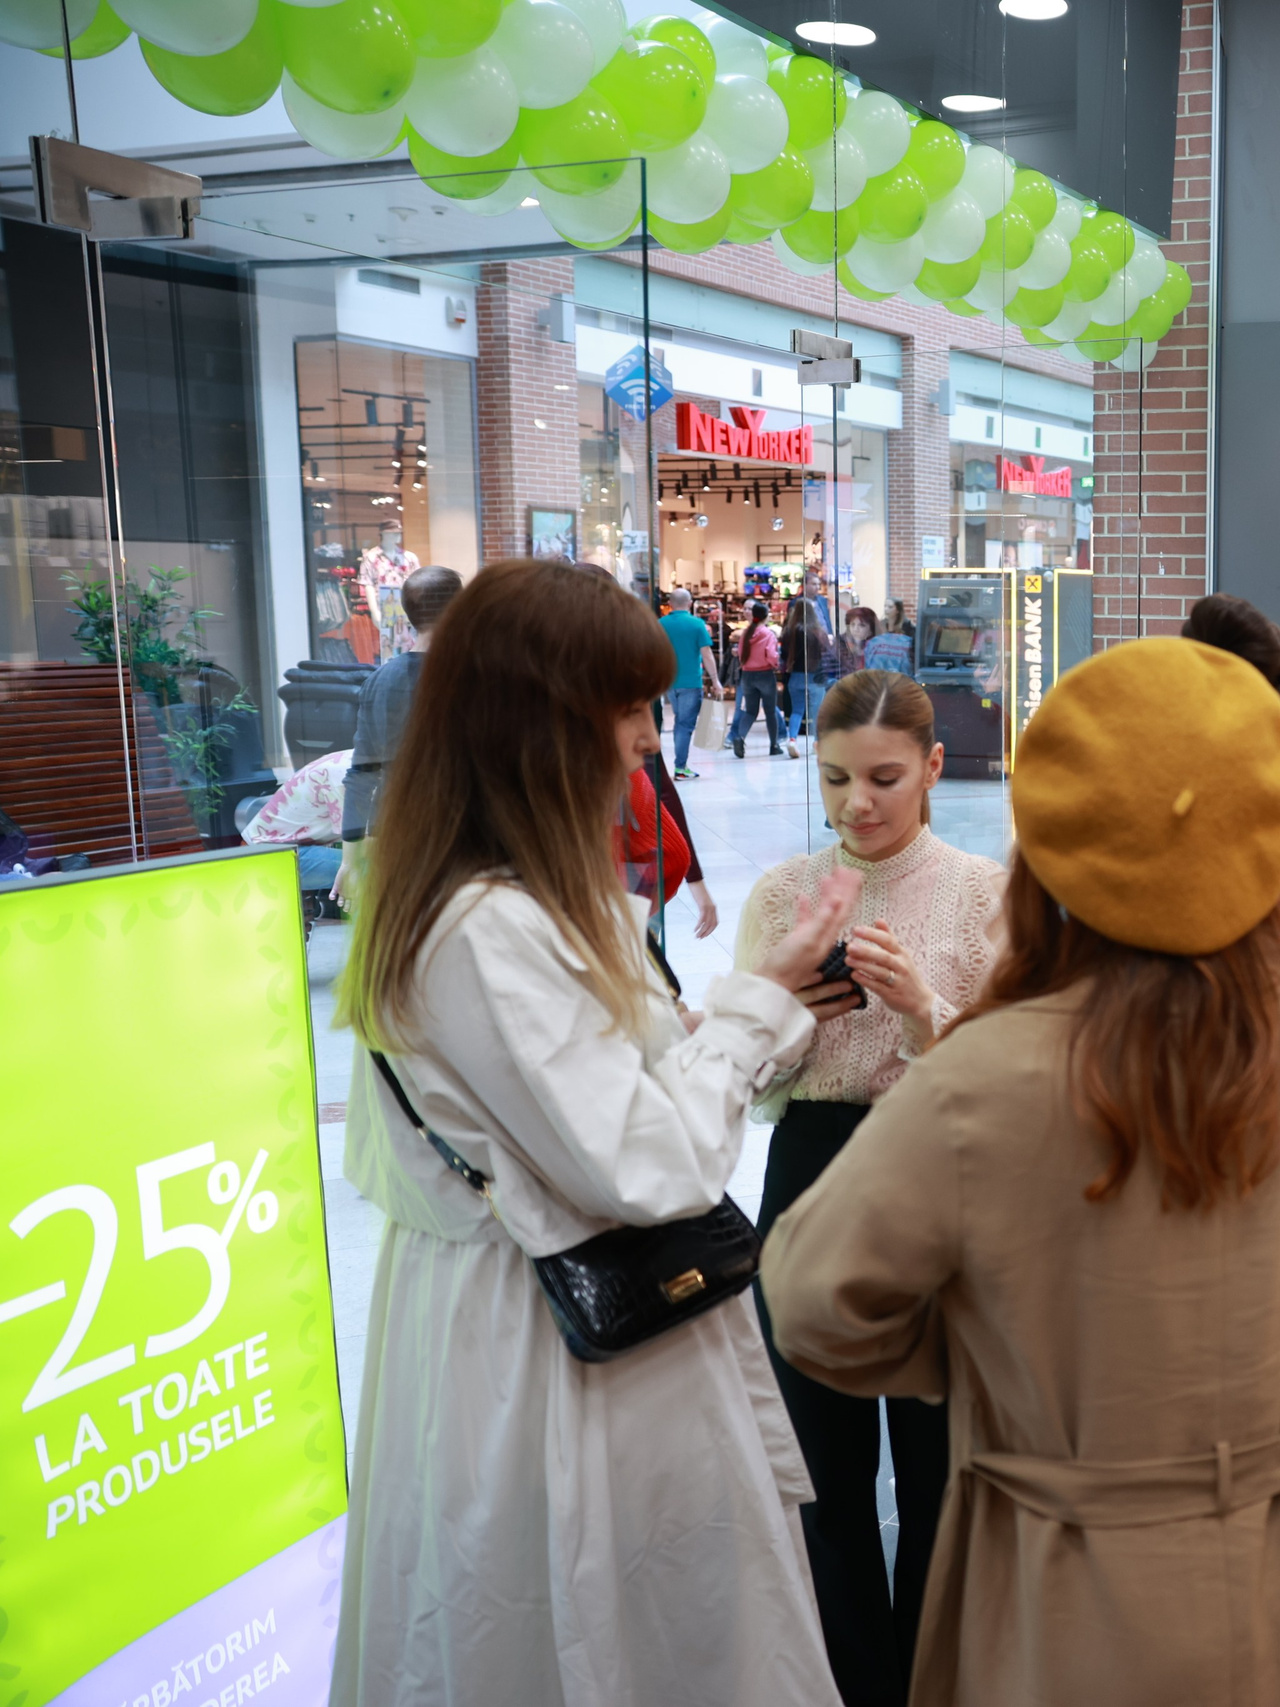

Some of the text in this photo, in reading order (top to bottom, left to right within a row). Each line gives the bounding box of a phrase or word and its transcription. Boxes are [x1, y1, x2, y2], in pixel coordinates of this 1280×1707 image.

[1024, 597, 1041, 664] BANK
[34, 1332, 270, 1483] LA TOATE
[45, 1390, 275, 1540] PRODUSELE
